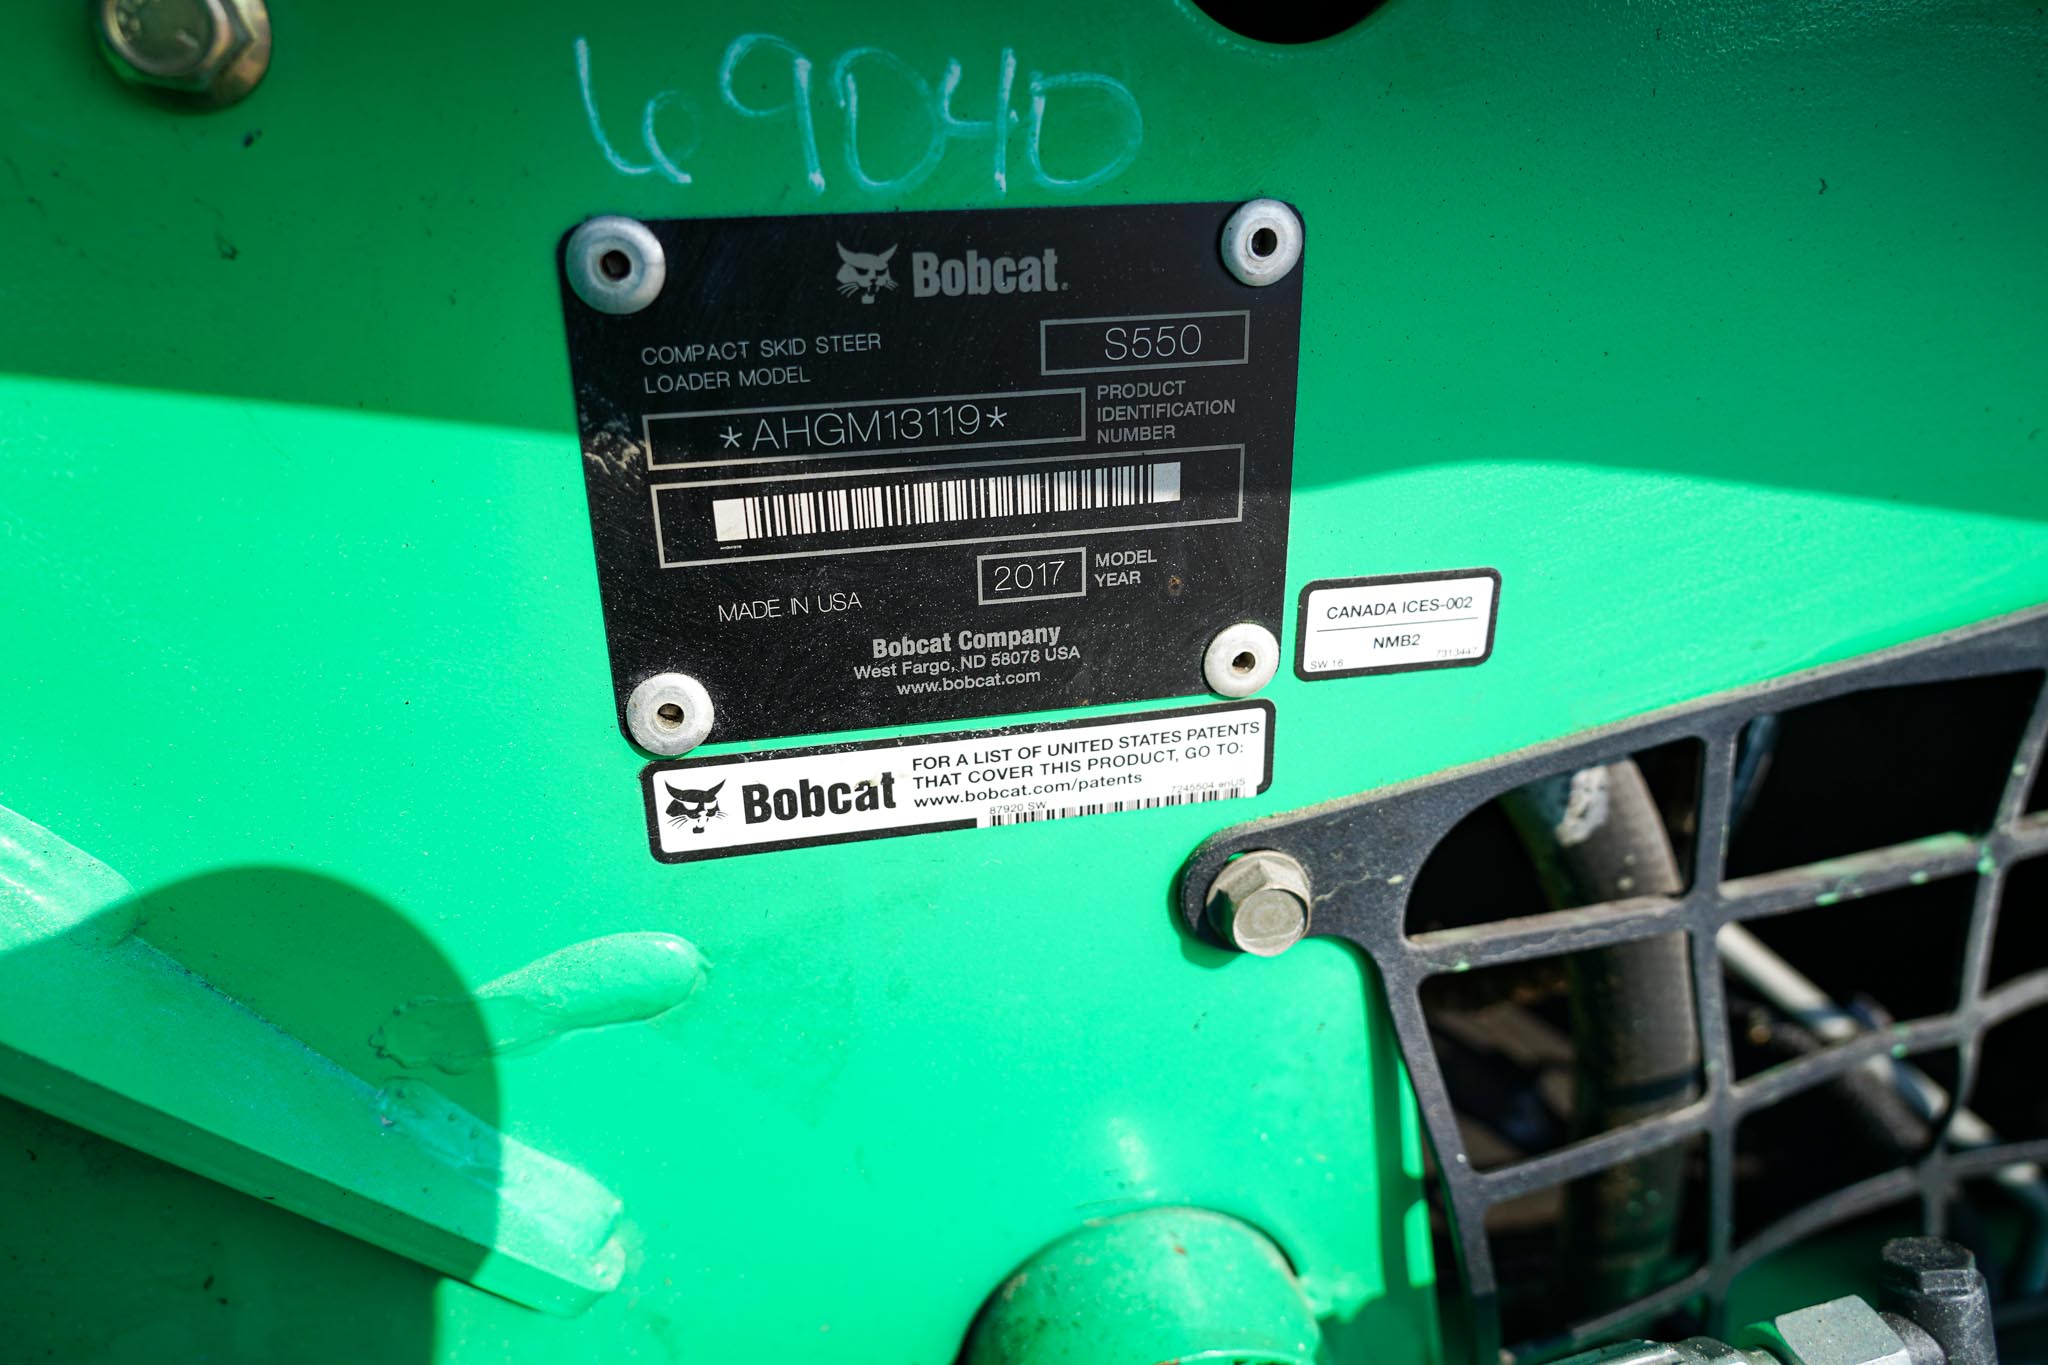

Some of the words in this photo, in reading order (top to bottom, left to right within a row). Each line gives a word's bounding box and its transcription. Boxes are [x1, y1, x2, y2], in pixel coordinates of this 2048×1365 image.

[574, 33, 1144, 195] 69040
[912, 248, 1058, 298] Bobcat
[641, 341, 750, 366] COMPACT
[760, 337, 807, 359] SKID
[815, 332, 882, 355] STEER
[1104, 323, 1203, 361] S550
[643, 370, 731, 394] LOADER
[739, 366, 811, 387] MODEL
[1097, 379, 1187, 401] PRODUCT
[1097, 398, 1237, 423] IDENTIFICATION
[1097, 424, 1176, 444] NUMBER
[1095, 549, 1158, 568] MODEL
[994, 560, 1066, 592] 2017
[1094, 570, 1142, 588] YEAR
[718, 598, 782, 622] MADE
[790, 595, 809, 616] IN
[817, 591, 863, 613] USA
[1326, 601, 1397, 620] CANADA
[1402, 595, 1473, 615] ICES-002
[872, 632, 952, 659] Bobcat
[958, 626, 1062, 650] Company
[1373, 633, 1422, 650] NMB2
[853, 664, 897, 680] West
[902, 659, 956, 676] Fargo,
[960, 654, 987, 669] ND
[991, 650, 1041, 667] 58078
[1045, 645, 1081, 662] USA
[1310, 660, 1329, 670] SW
[1331, 658, 1344, 668] 16
[897, 671, 1042, 695] www.bobcat.com
[912, 755, 951, 772] FOR
[956, 753, 969, 767] A
[974, 748, 1013, 765] LIST
[1017, 745, 1042, 760] OF
[1047, 737, 1114, 757] UNITED
[1118, 730, 1182, 749] STATES
[1187, 721, 1261, 741] PATENTS
[913, 772, 962, 789] THAT
[968, 765, 1034, 784] COVER
[1040, 759, 1082, 776] THIS
[1087, 749, 1179, 771] PRODUCT,
[1185, 745, 1211, 760] GO
[1217, 742, 1244, 756] TO:
[742, 772, 897, 825] Bobcat
[914, 773, 1143, 808] www.bobcat.com/patents
[989, 803, 1024, 815] 87920
[1027, 801, 1047, 811] SW
